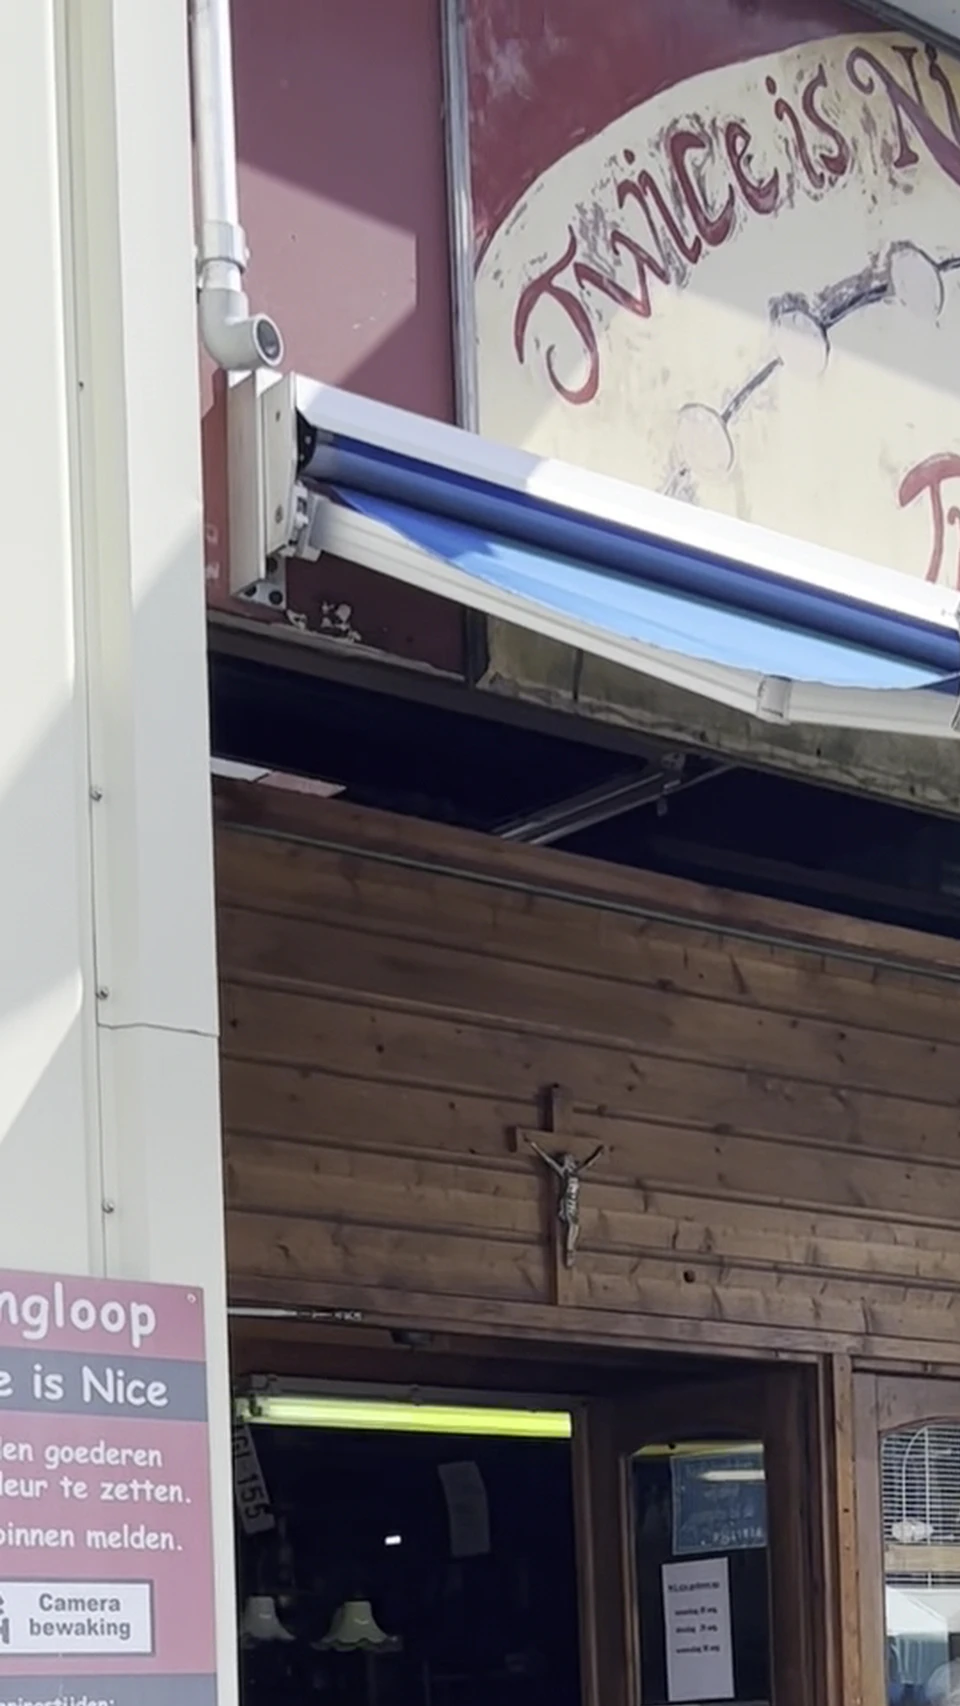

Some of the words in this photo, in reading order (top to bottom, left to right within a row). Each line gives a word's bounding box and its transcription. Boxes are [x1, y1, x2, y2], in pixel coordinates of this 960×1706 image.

[514, 121, 778, 405] Twice
[766, 64, 850, 190] is
[0, 1281, 156, 1349] ngloop
[33, 1363, 64, 1400] is
[82, 1365, 169, 1407] Nice
[0, 1436, 33, 1462] en
[45, 1440, 162, 1469] goederen
[0, 1471, 48, 1498] eur
[60, 1476, 88, 1499] te
[100, 1479, 192, 1504] zetten.
[86, 1524, 184, 1551] melden.
[39, 1593, 121, 1612] Camera
[29, 1618, 131, 1641] bewaking
